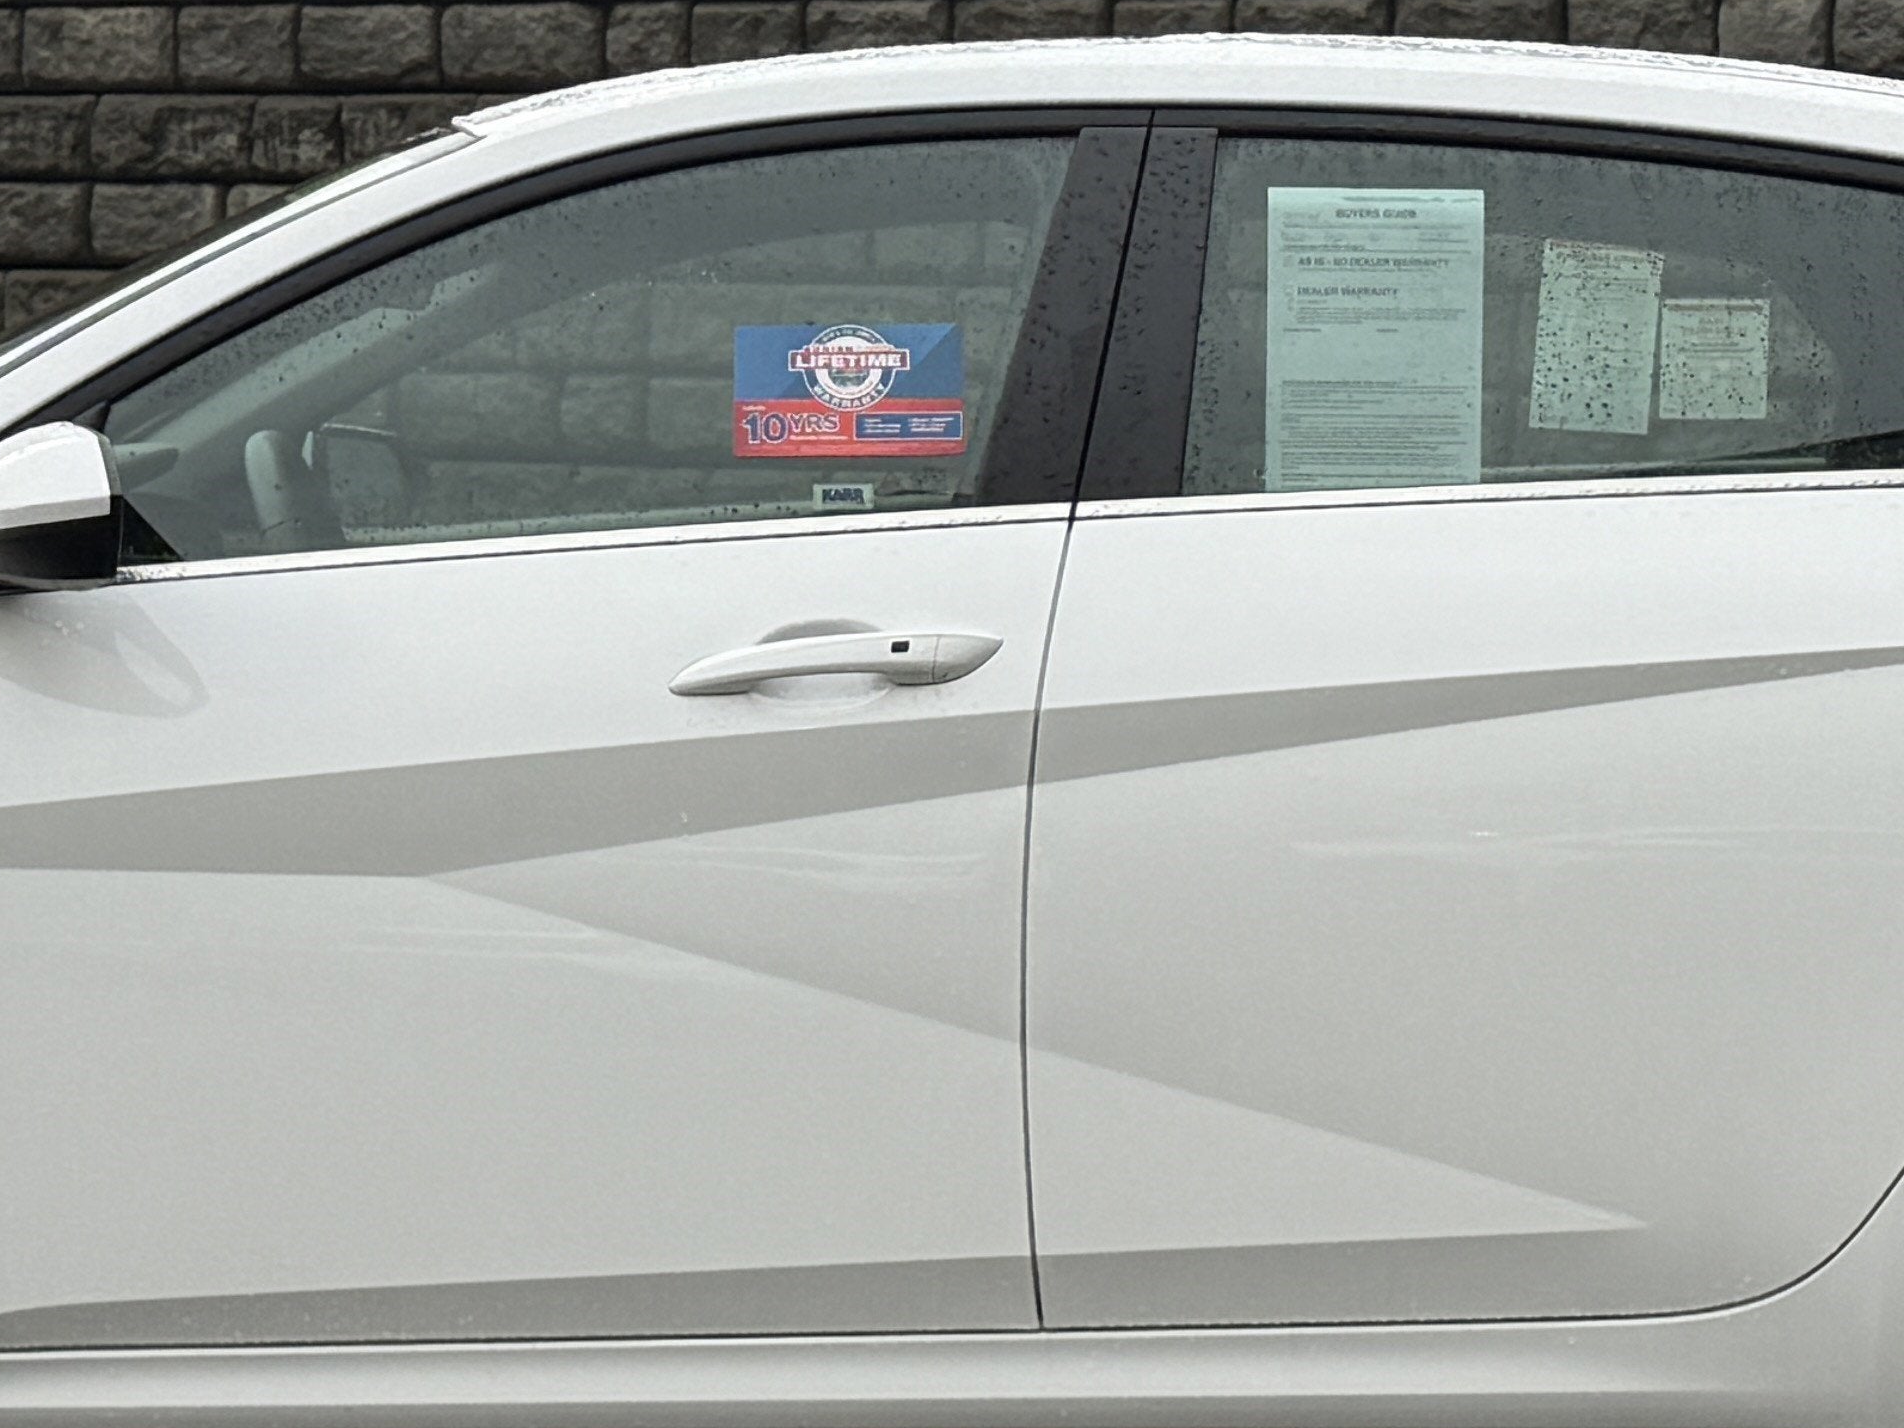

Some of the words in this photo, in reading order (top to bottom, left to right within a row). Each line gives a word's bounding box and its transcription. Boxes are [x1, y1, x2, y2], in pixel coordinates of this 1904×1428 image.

[796, 354, 902, 368] LIFETIME
[743, 412, 788, 444] 10
[788, 412, 840, 433] YRS
